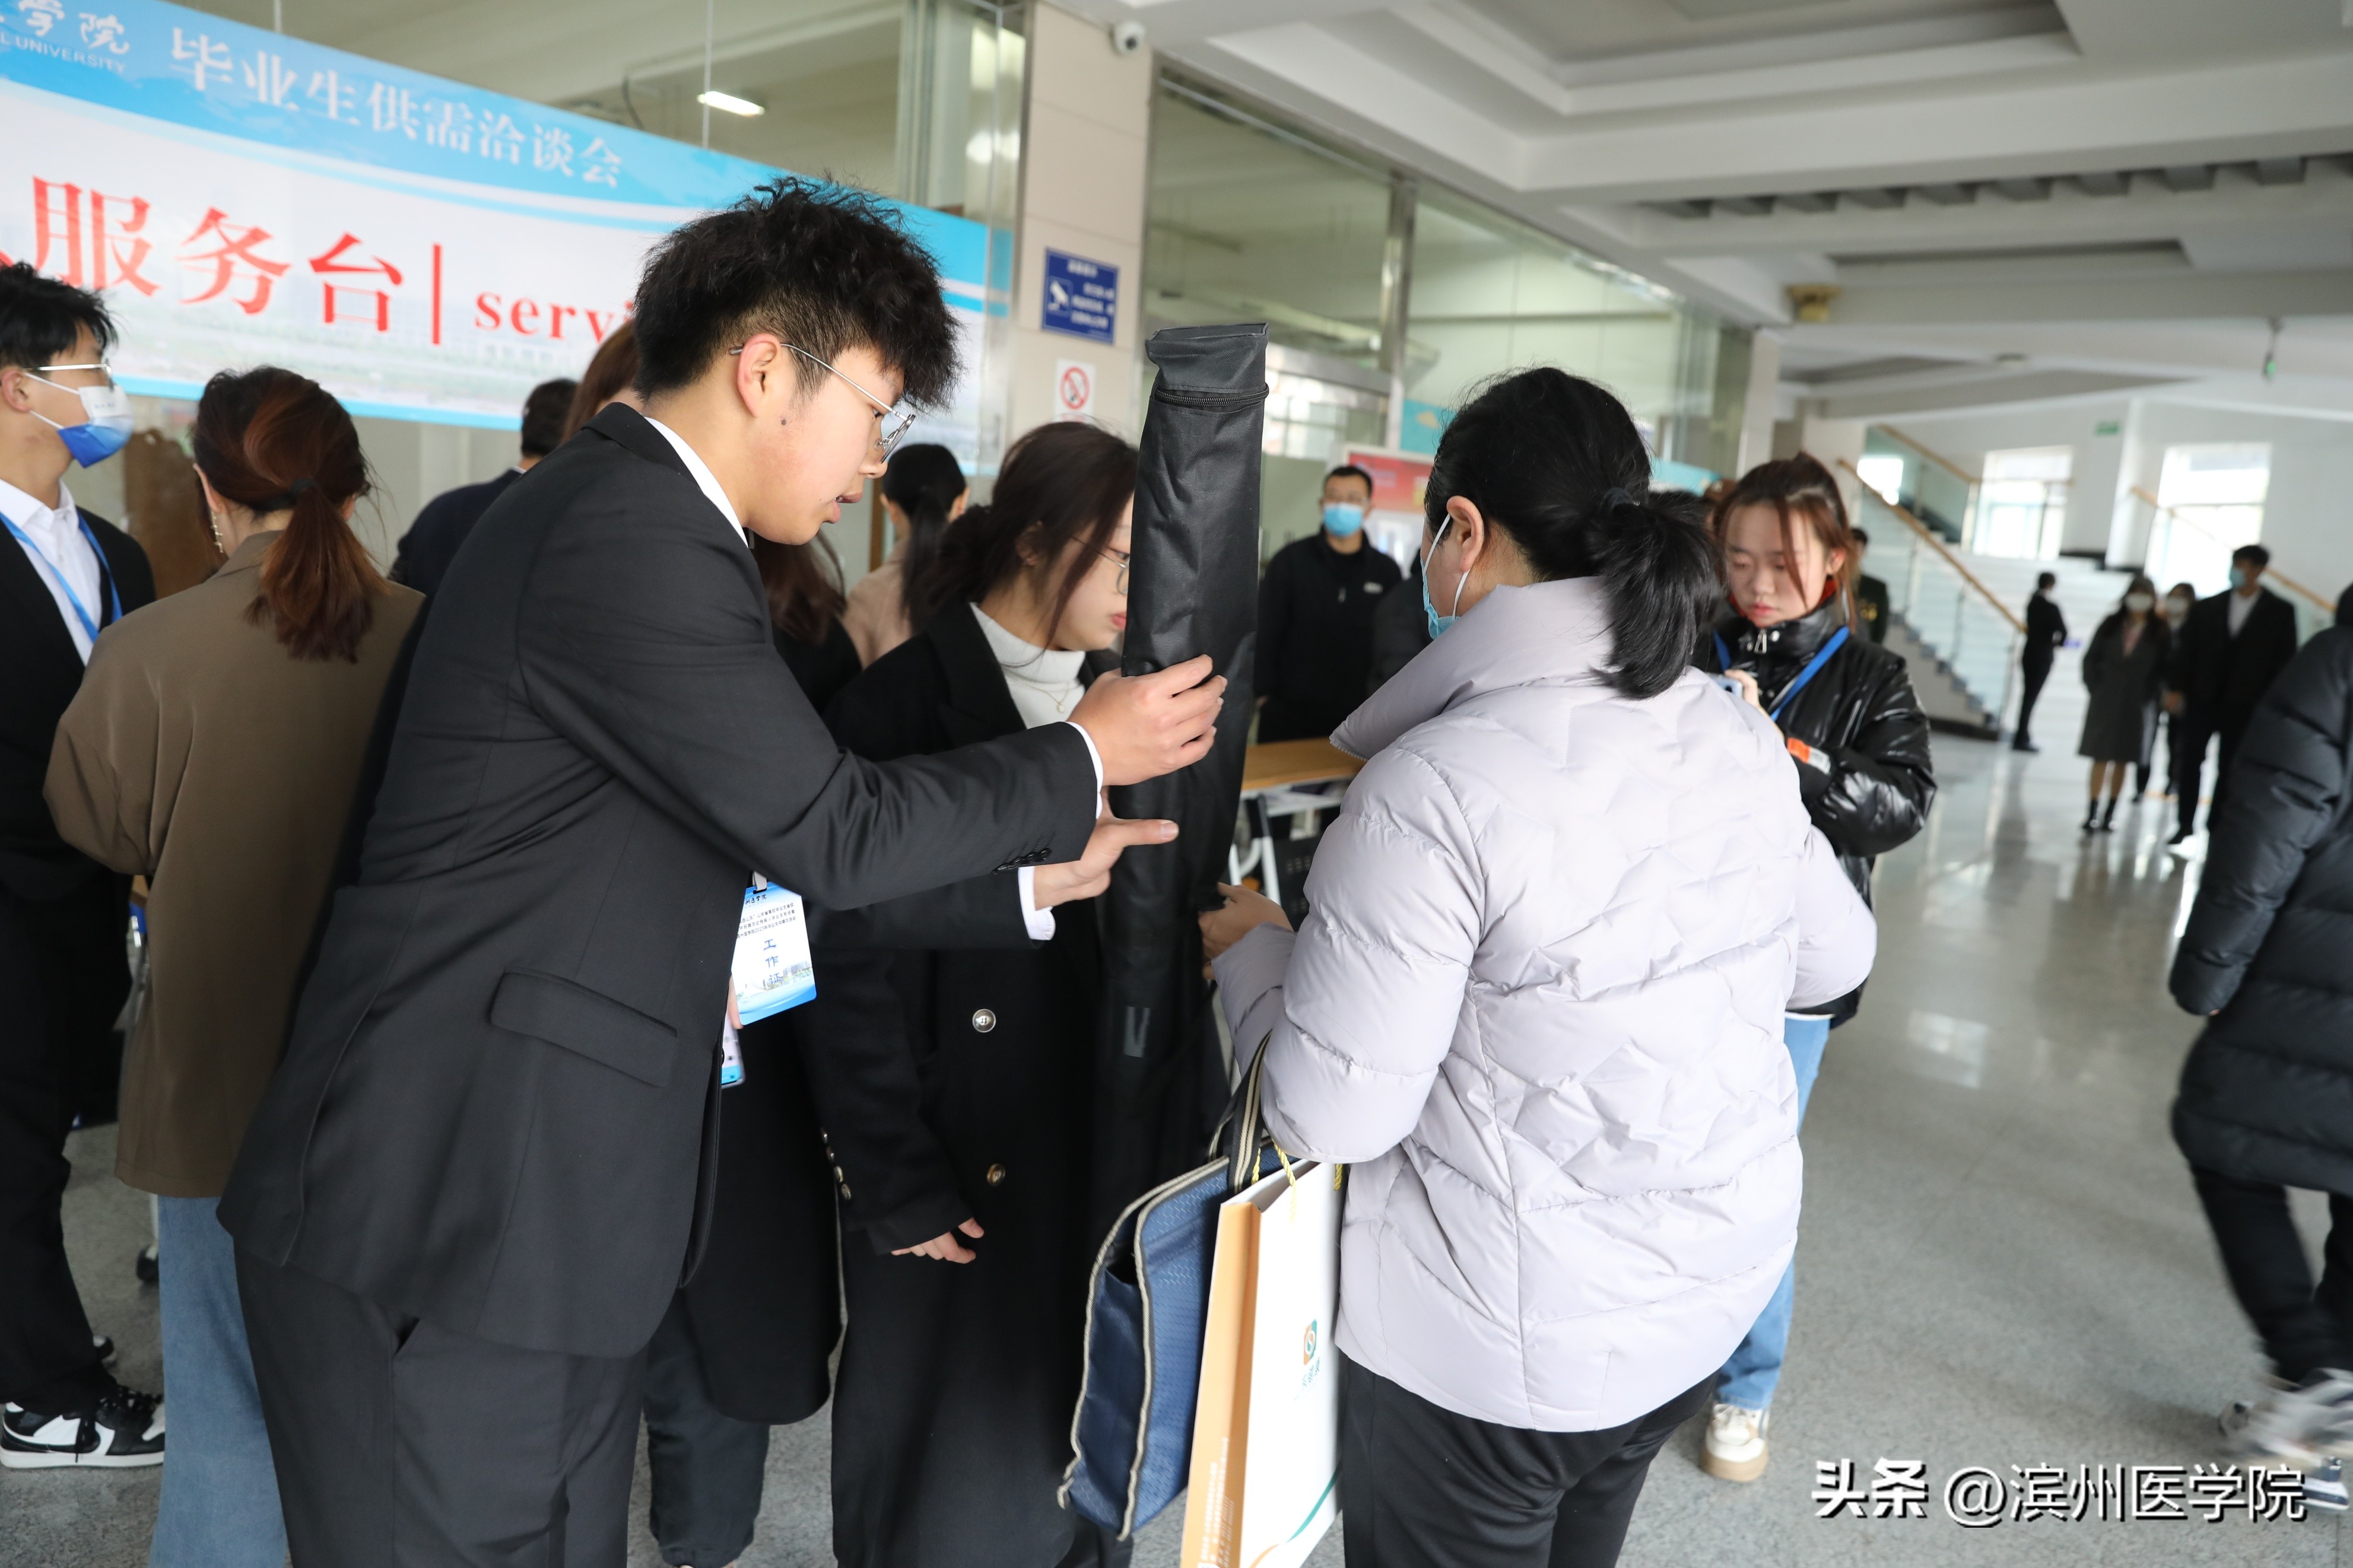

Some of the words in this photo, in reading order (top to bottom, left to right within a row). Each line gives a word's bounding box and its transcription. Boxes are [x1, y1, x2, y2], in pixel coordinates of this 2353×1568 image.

[15, 35, 126, 74] UNIVERSITY
[170, 27, 622, 189] 毕业生供需洽谈会
[0, 174, 404, 332] 服务台
